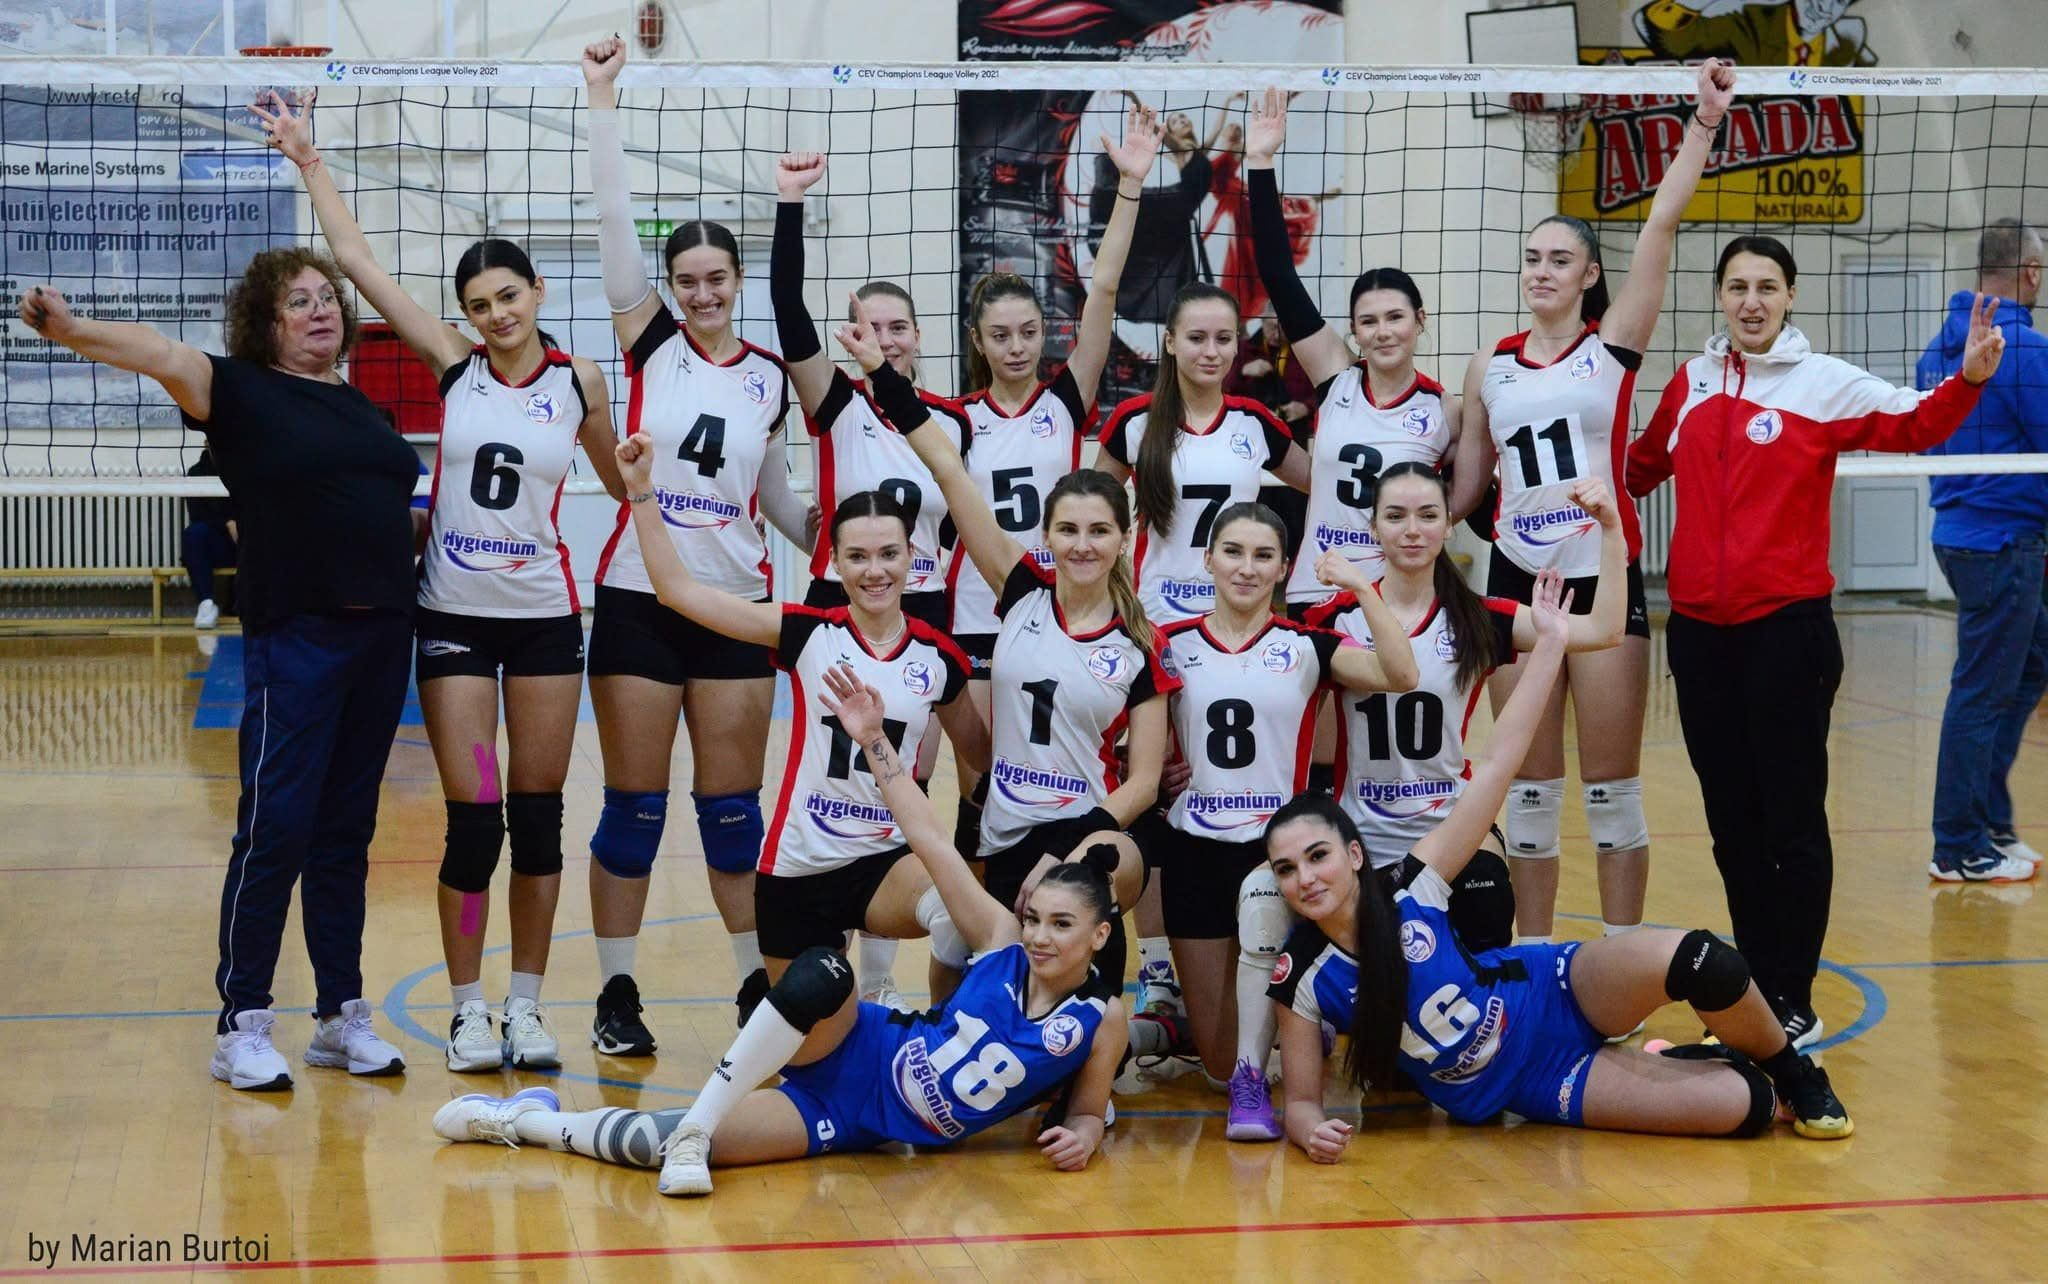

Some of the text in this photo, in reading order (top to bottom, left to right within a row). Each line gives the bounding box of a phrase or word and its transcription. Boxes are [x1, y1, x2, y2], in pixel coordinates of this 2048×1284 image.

[353, 67, 498, 76] CEV Champions League Volley 2021
[858, 70, 999, 79] CEV Champions League Volley 2021
[1346, 72, 1481, 82] CEV Champions League Volley 2021
[1812, 76, 1942, 86] CEV Champions League Volley 2021
[1601, 94, 1856, 206] ARADA
[35, 161, 90, 175] Marine
[95, 161, 165, 178] Systems
[1757, 168, 1849, 197] 100%
[51, 200, 150, 221] electrice
[157, 200, 260, 223] integrate
[46, 230, 150, 250] domeniul
[157, 230, 216, 250] naval
[75, 293, 119, 303] tablouri
[121, 293, 172, 303] electrice
[139, 308, 211, 318] automatizare
[677, 413, 726, 479] 4
[1505, 418, 1578, 488] 11
[470, 442, 524, 510] 6
[1336, 443, 1383, 510] 3
[653, 488, 741, 518] Hygienium
[992, 467, 1040, 532] 5
[1182, 484, 1231, 548] 7
[1513, 506, 1590, 532] Hygieniu
[443, 530, 537, 556] Hygienium
[1160, 579, 1216, 599] Hygien
[1021, 678, 1058, 746] 1
[1355, 690, 1443, 761] 10
[1206, 698, 1256, 769] 8
[994, 759, 1089, 794] Hygienium
[1359, 777, 1453, 802] Hygienium
[1187, 790, 1281, 813] Hygienium
[928, 1009, 1026, 1111] 18
[909, 1040, 964, 1138] Hygienium
